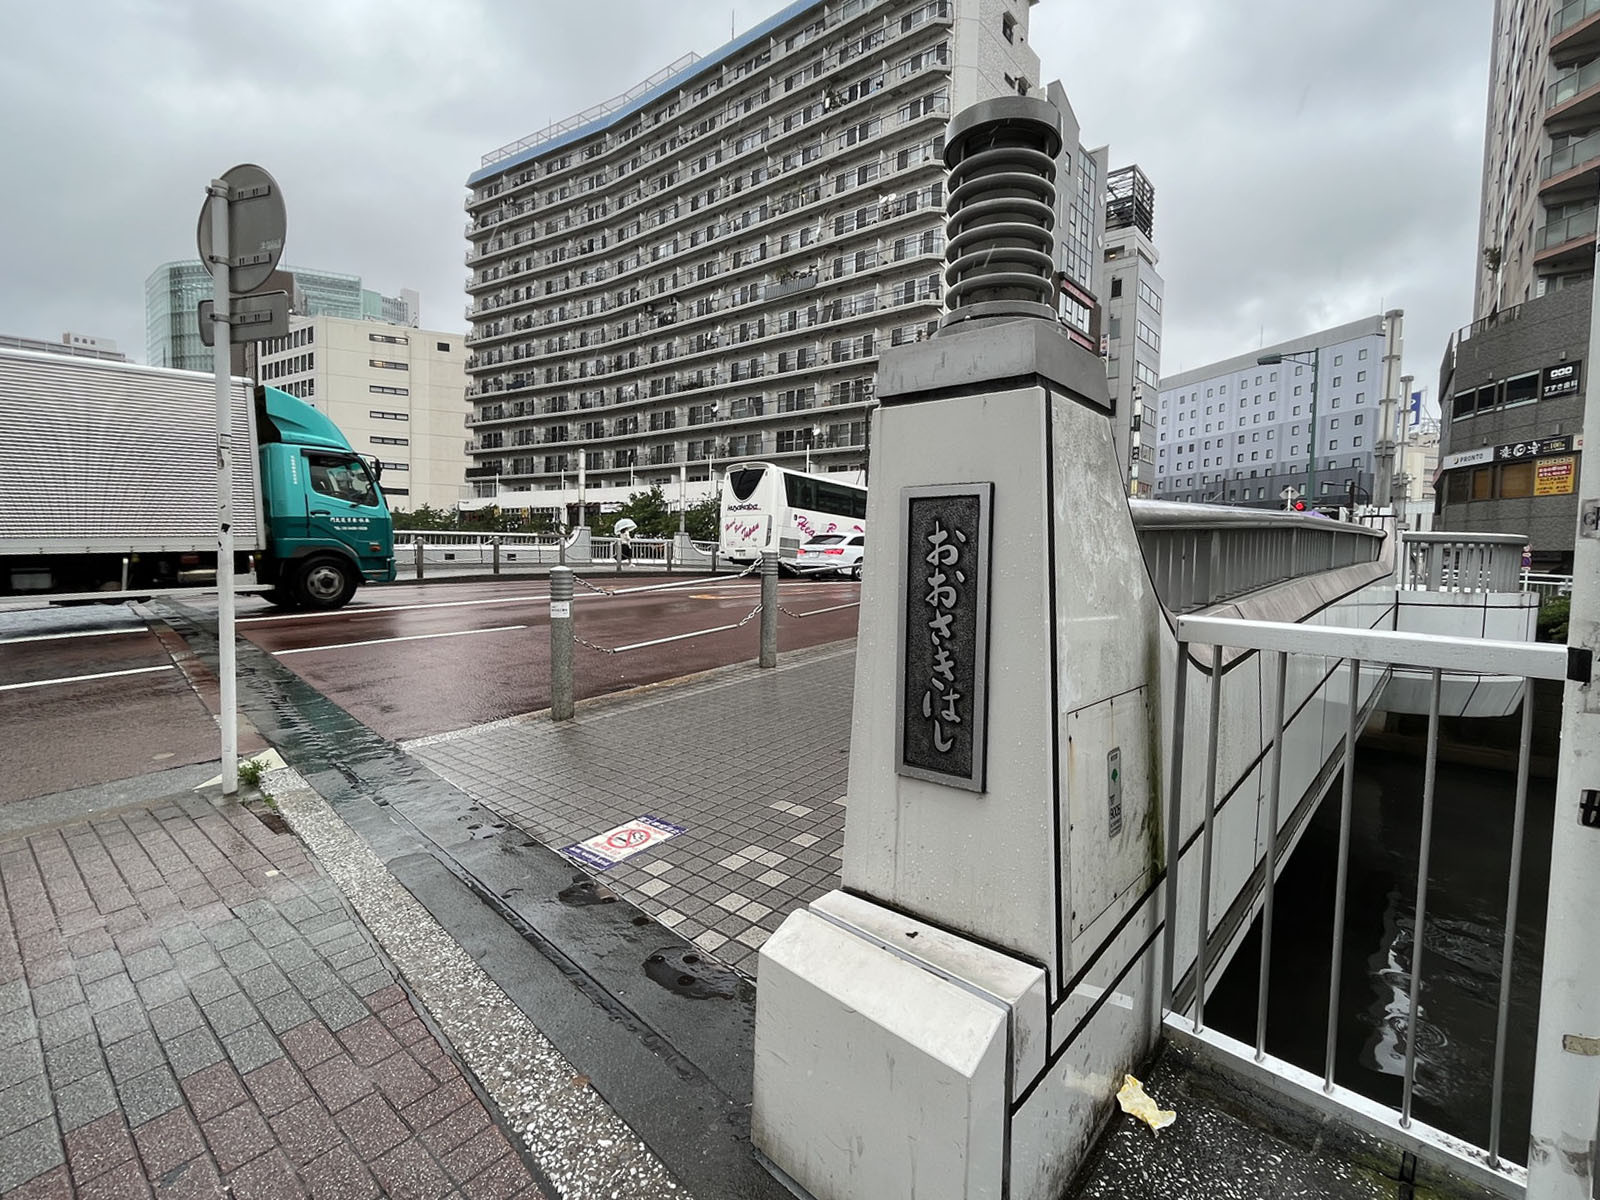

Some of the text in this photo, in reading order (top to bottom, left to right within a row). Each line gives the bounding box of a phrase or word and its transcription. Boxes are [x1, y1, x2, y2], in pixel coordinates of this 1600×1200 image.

[1460, 453, 1483, 463] PRONTO
[922, 520, 967, 753] おおさきはし
